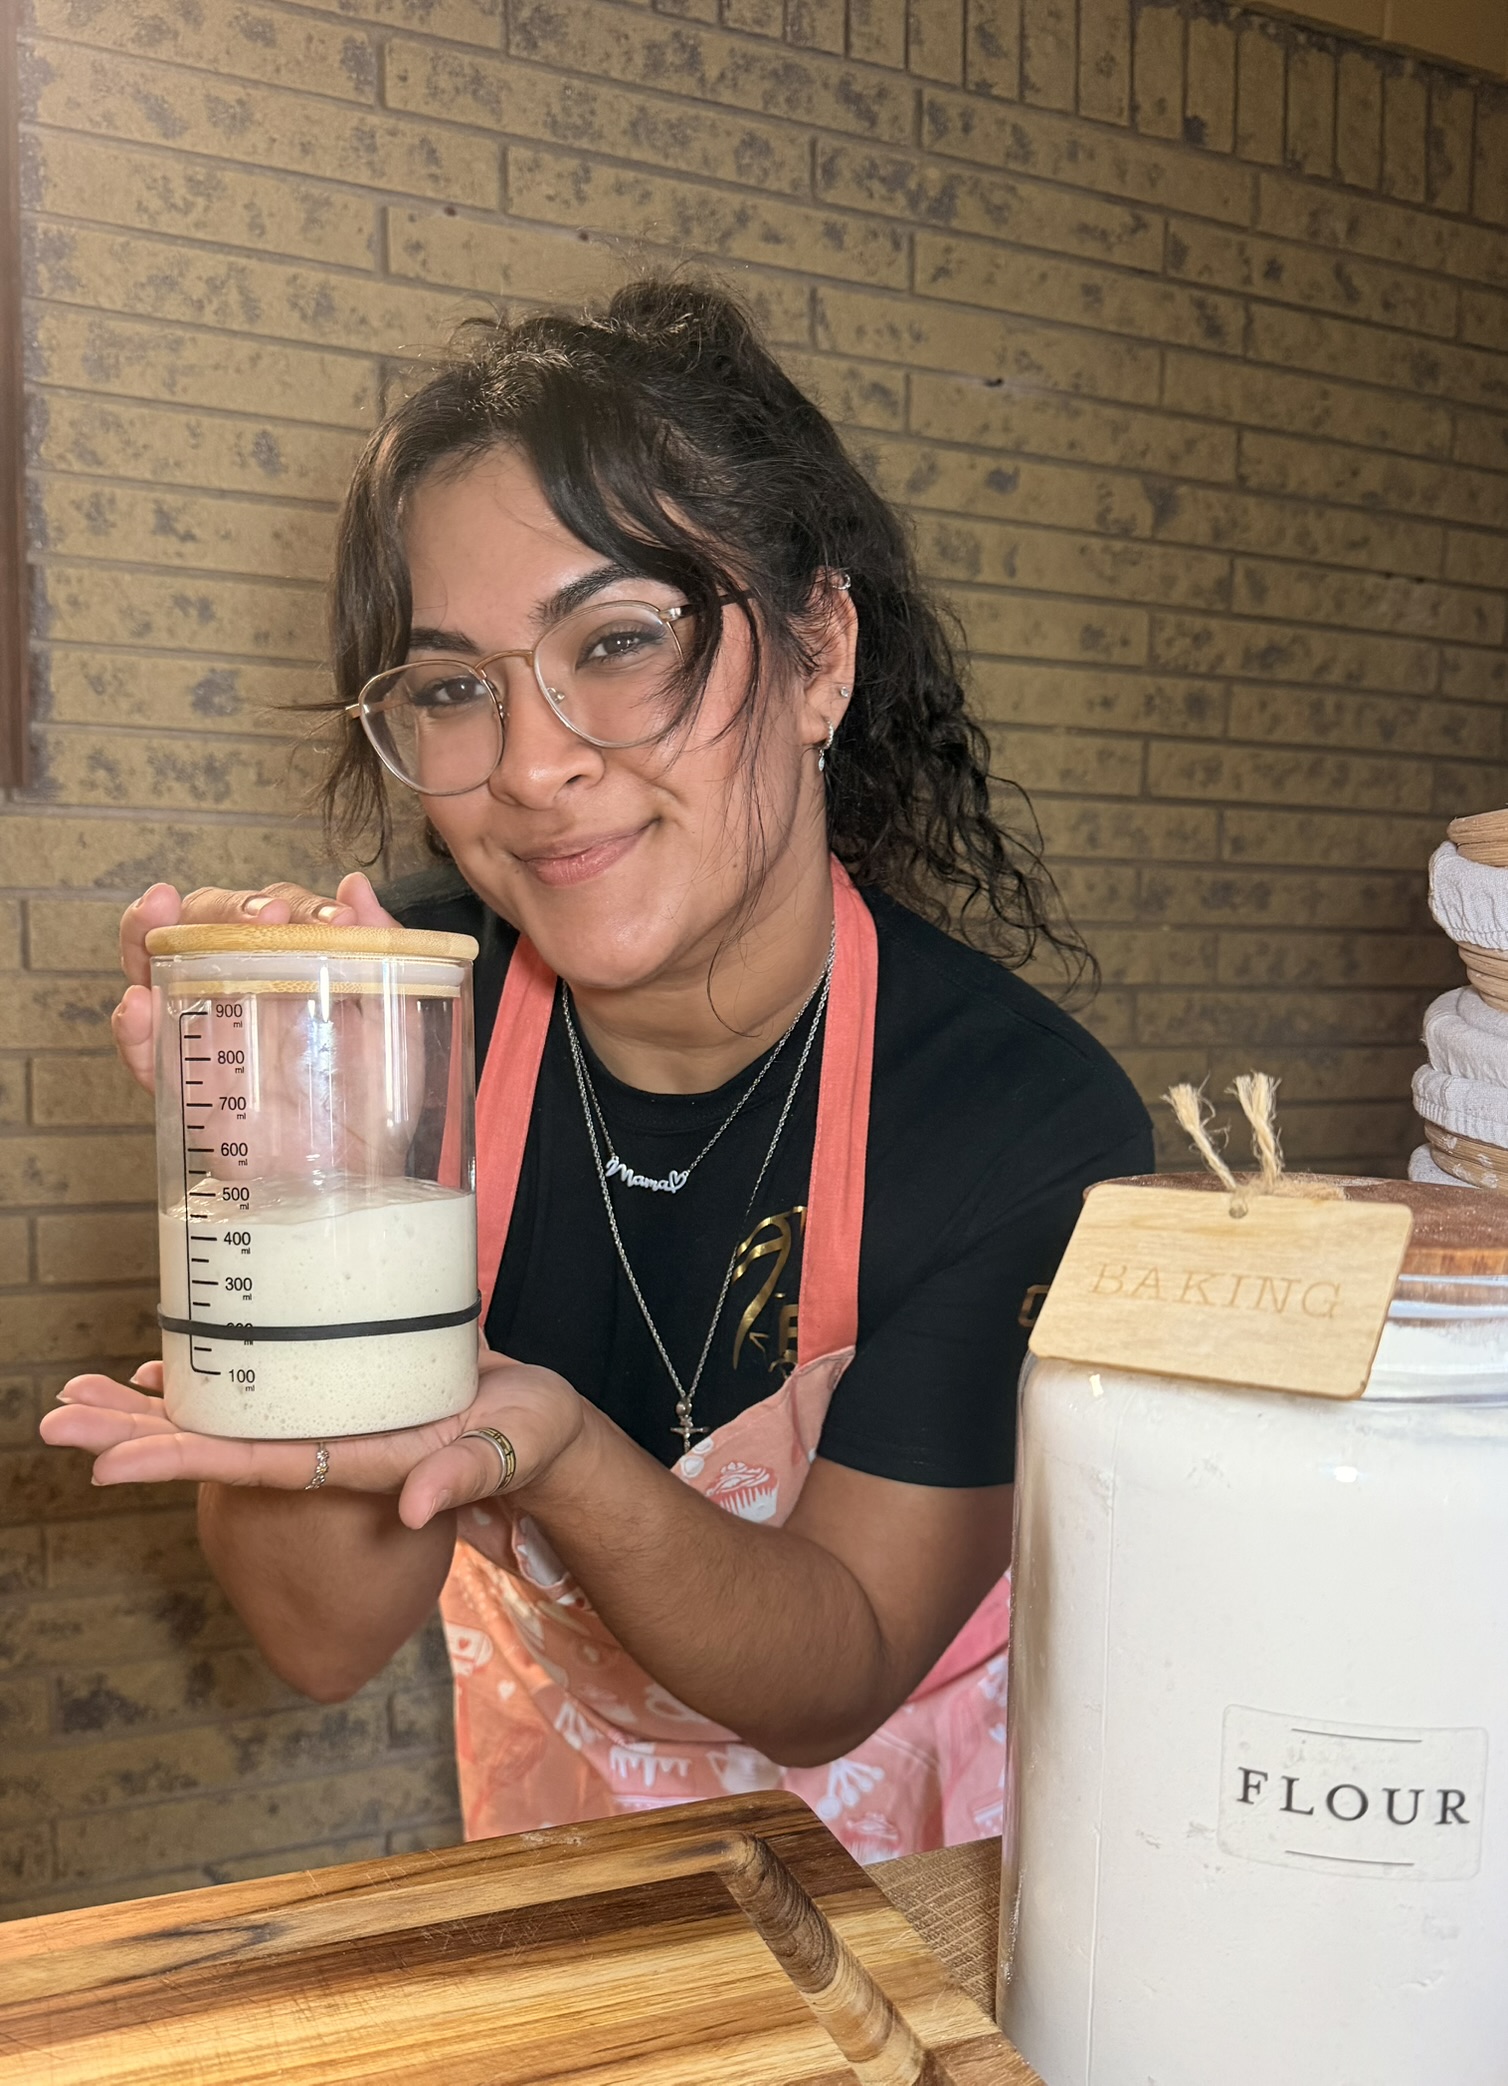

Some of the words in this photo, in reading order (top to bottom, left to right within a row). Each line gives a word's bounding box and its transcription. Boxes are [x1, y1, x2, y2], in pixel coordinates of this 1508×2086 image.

[215, 1003, 243, 1018] 900
[232, 1020, 243, 1029] ml
[217, 1049, 245, 1065] 800
[234, 1065, 245, 1074] ml
[218, 1095, 247, 1111] 700
[236, 1112, 247, 1120] ml
[220, 1142, 249, 1157] 600
[237, 1158, 249, 1167] ml
[605, 1156, 669, 1192] Mama
[221, 1186, 250, 1202] 500
[239, 1202, 250, 1211] ml
[223, 1231, 252, 1246] 400
[240, 1246, 252, 1255] ml
[224, 1276, 253, 1292] 300
[1090, 1262, 1342, 1319] BAKING
[242, 1292, 253, 1301] ml
[227, 1368, 256, 1384] 100
[244, 1384, 256, 1393] ml
[1235, 1766, 1470, 1826] FLOUR
